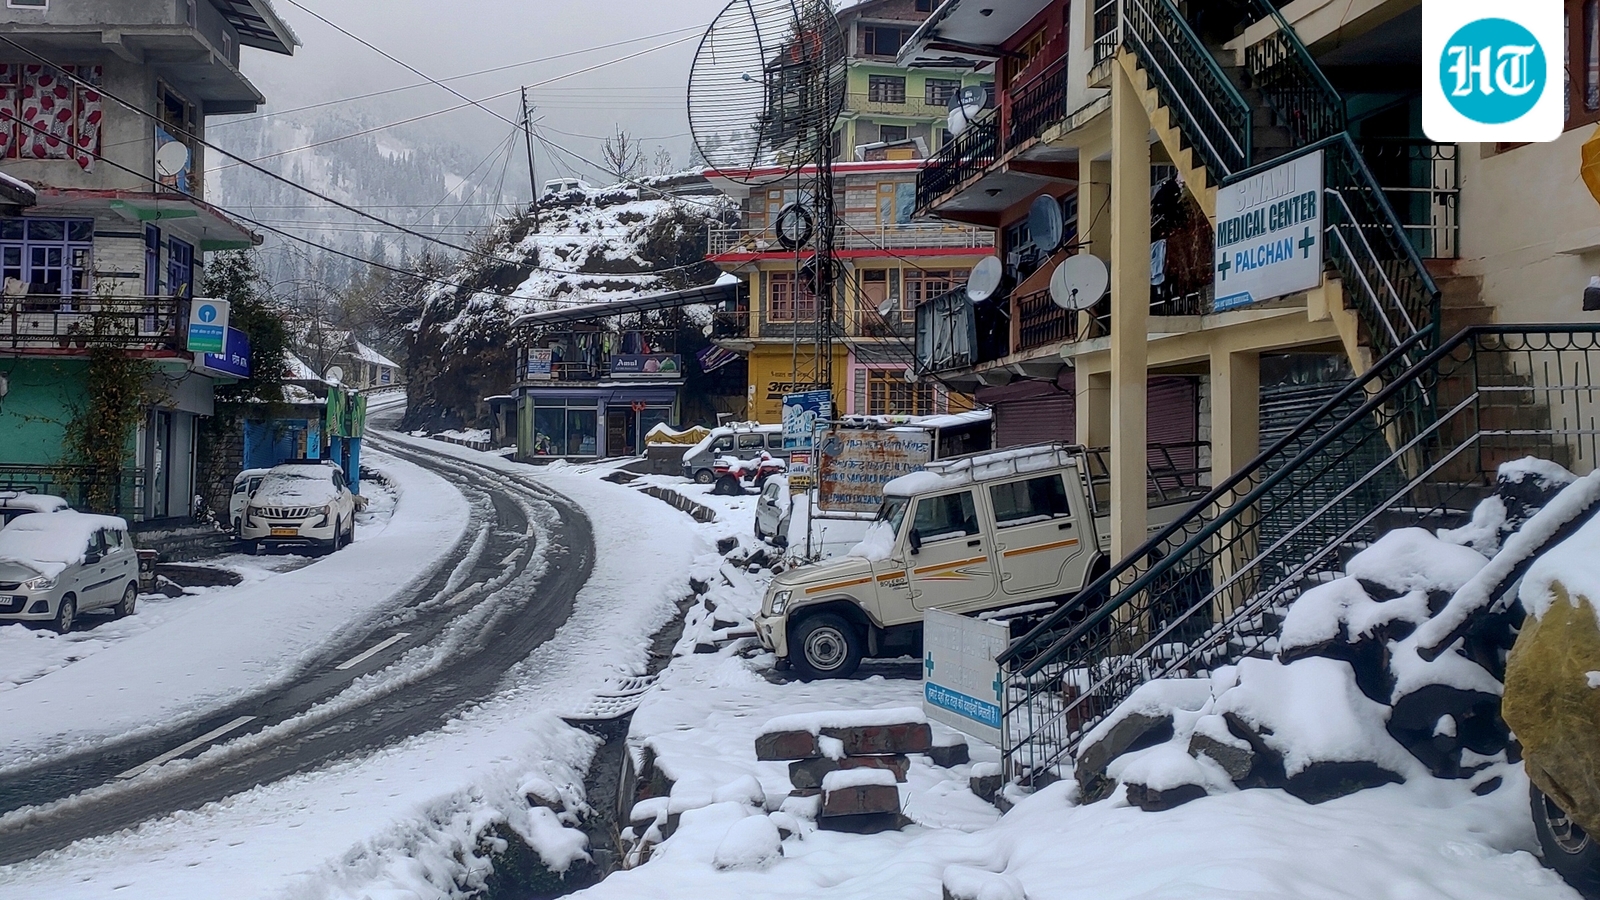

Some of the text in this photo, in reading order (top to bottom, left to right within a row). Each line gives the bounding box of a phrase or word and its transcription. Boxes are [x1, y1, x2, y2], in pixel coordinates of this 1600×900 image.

[1236, 163, 1296, 212] SWAMI
[1217, 190, 1317, 249] MEDICAL CENTER
[1235, 236, 1294, 273] PALCHAN
[616, 358, 638, 367] Amul
